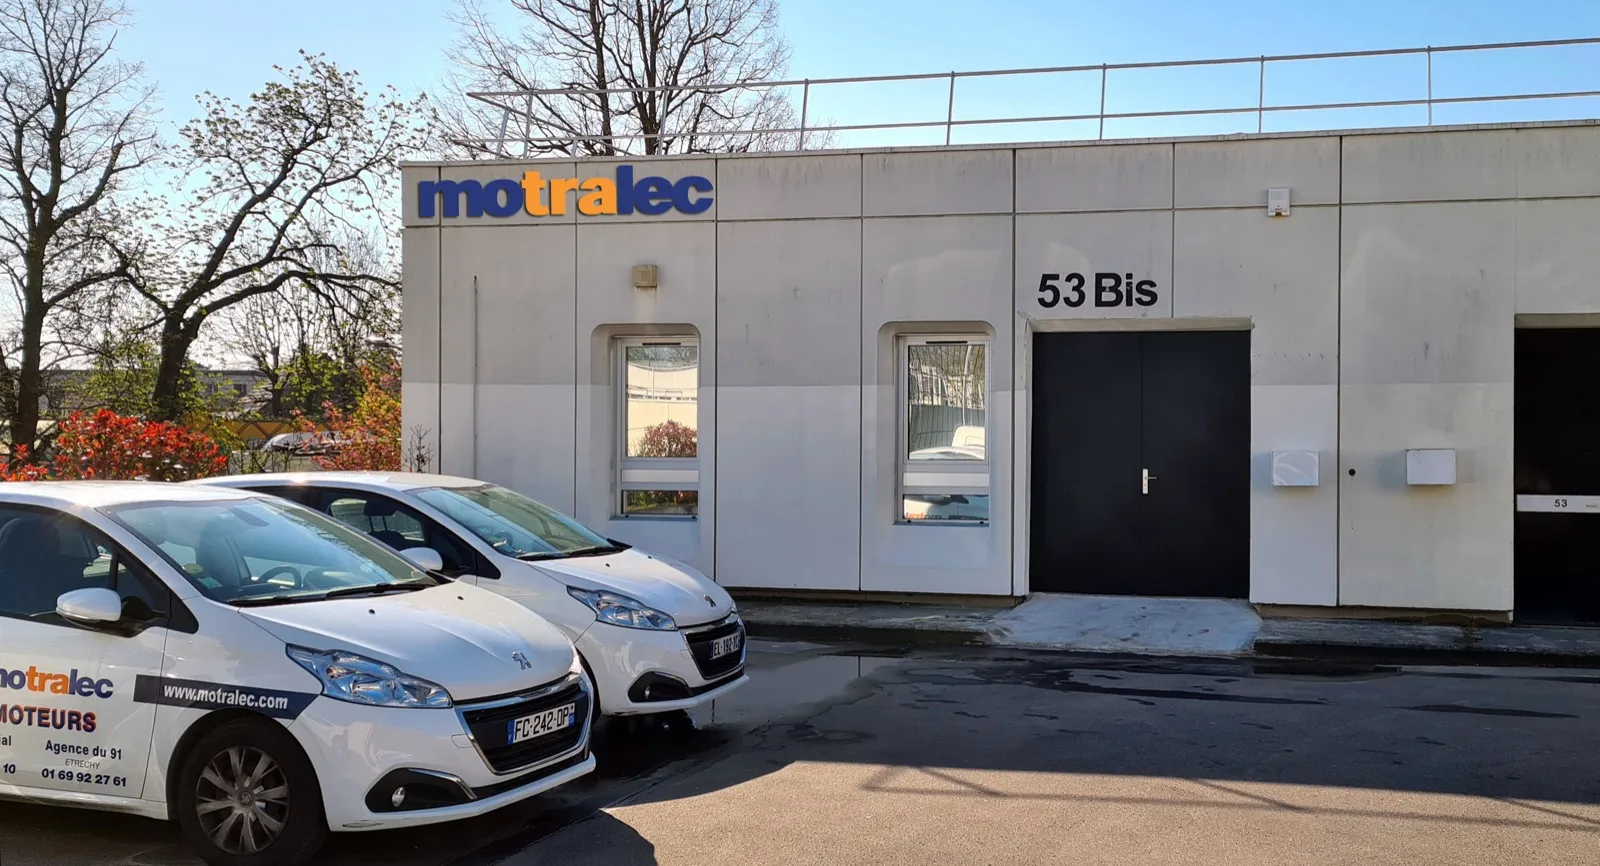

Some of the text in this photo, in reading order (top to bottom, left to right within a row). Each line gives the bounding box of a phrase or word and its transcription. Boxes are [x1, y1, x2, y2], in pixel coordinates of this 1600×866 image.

[418, 165, 714, 217] motralec
[1037, 272, 1158, 308] 53 Bis
[1554, 498, 1568, 508] 53
[0, 665, 114, 699] otralec
[163, 684, 288, 710] www.motralec.com
[0, 734, 12, 747] al
[45, 740, 122, 760] Agence du 91
[3, 763, 16, 775] 10
[41, 768, 127, 787] 01 69 92 27 61
